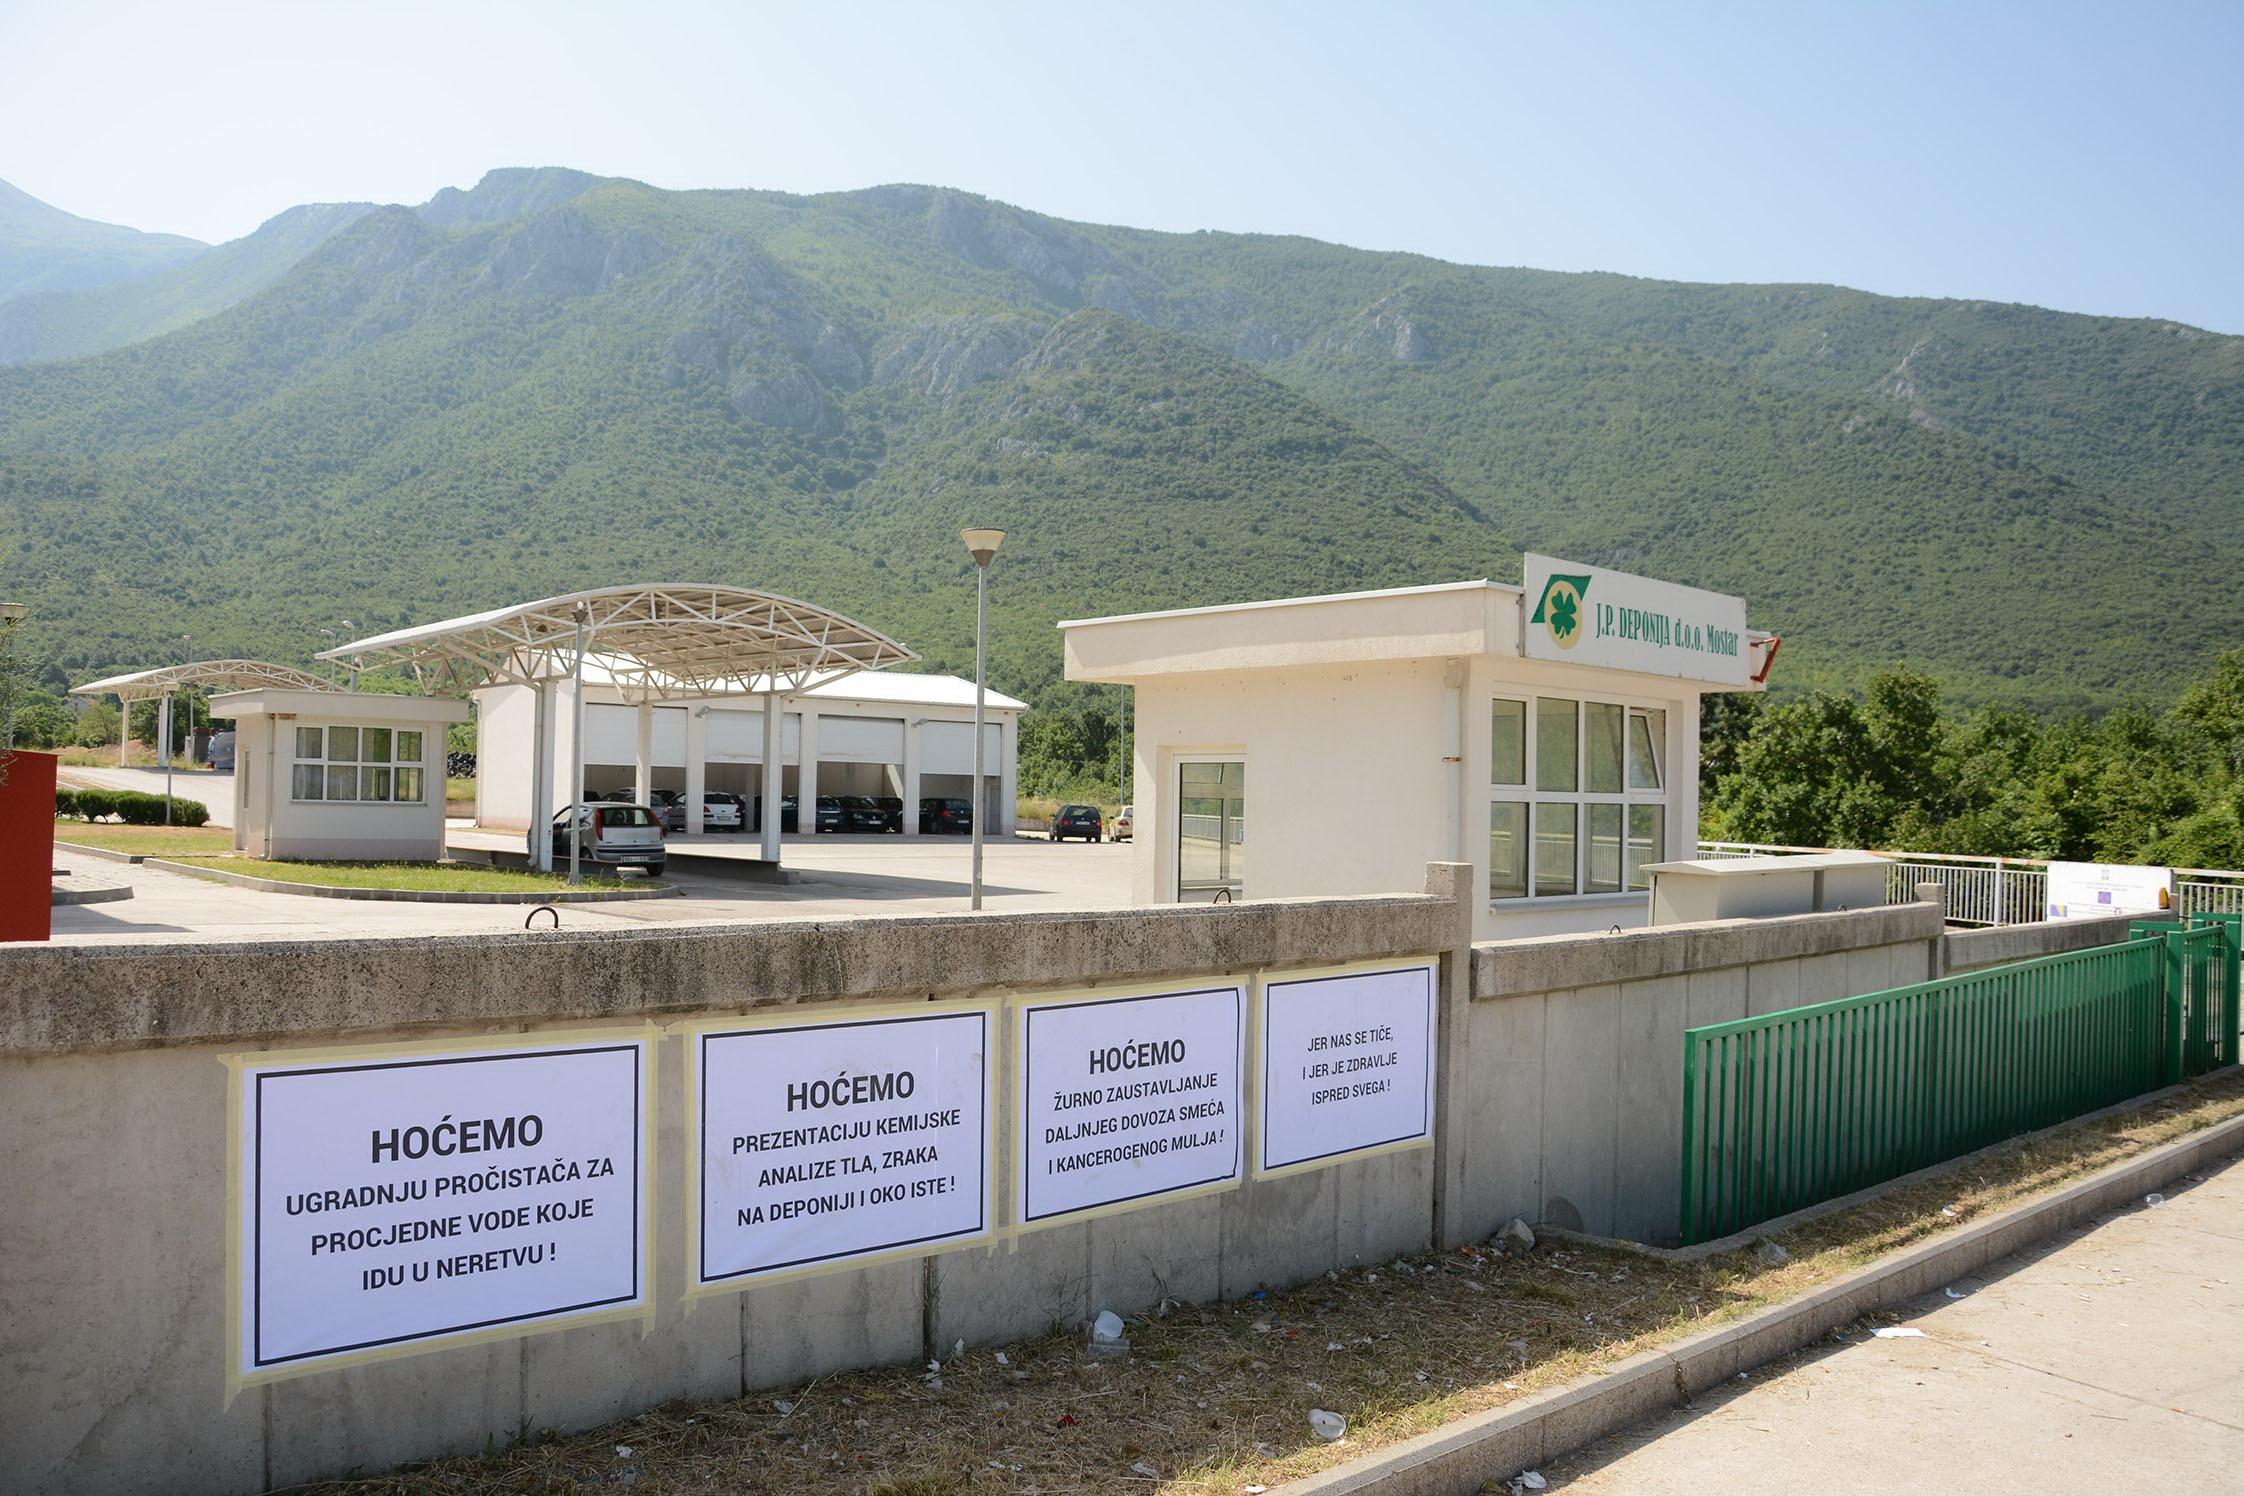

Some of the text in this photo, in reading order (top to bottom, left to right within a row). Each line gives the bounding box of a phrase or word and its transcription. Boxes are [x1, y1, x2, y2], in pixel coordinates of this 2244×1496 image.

[1595, 603, 1738, 657] J.P. DEPONIJA d.o.o. Mostar
[1089, 1038, 1186, 1075] HOĆEMO
[1307, 1024, 1394, 1053] JER NAS SE TIČE,
[1302, 1051, 1398, 1081] I JER JE ZDRAVLJE
[787, 1070, 915, 1113] HOĆEMO
[1053, 1072, 1218, 1112] ŽURNO ZAUSTAVLJANJE
[1311, 1086, 1350, 1106] ISPRED
[1351, 1079, 1386, 1098] SVEGA
[371, 1114, 544, 1164] HOĆEMO
[732, 1108, 961, 1156] PREZENTACIJU KEMIJSKE
[1045, 1097, 1225, 1145] DALJNJEG DOVOZA SMEĆA
[757, 1145, 939, 1188] ANALIZE TLA, ZRAKA
[1048, 1159, 1053, 1175] I
[1056, 1138, 1168, 1174] KANCEROGENOG
[1170, 1130, 1217, 1152] MULJA
[286, 1156, 615, 1216] UGRADNJU PROČISTAČA ZA
[737, 1205, 765, 1227] NA
[769, 1191, 855, 1222] DEPONIJI
[859, 1189, 865, 1207] I
[869, 1183, 906, 1205] OKO
[910, 1176, 947, 1199] ISTE
[311, 1197, 594, 1257] PROCJEDNE VODE KOJE
[362, 1264, 405, 1291] IDU
[412, 1260, 429, 1283] U
[436, 1243, 544, 1280] NERETVU
